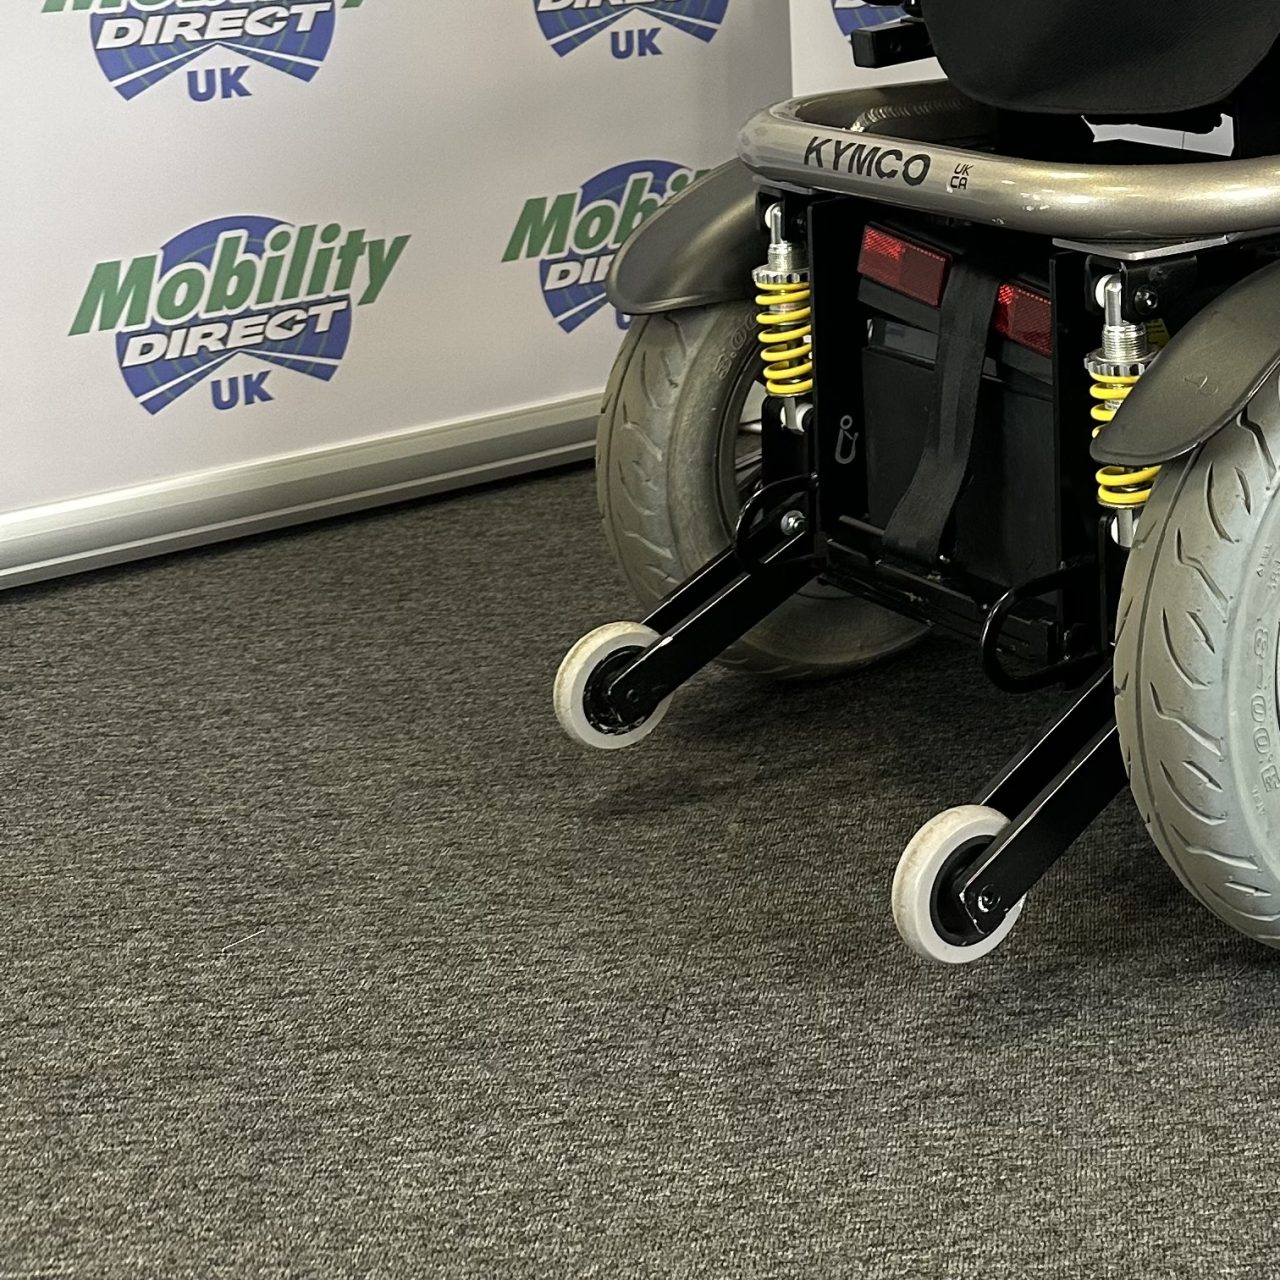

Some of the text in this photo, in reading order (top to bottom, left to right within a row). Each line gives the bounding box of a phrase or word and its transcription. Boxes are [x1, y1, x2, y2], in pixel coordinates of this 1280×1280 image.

[96, 2, 331, 49] DIRECT
[611, 28, 663, 59] UK
[187, 66, 253, 102] UK
[804, 136, 931, 186] KYMCO
[954, 163, 974, 176] UK
[950, 176, 968, 190] CA
[68, 223, 412, 336] Mobility
[121, 300, 348, 368] DIRECT
[211, 370, 274, 410] UK
